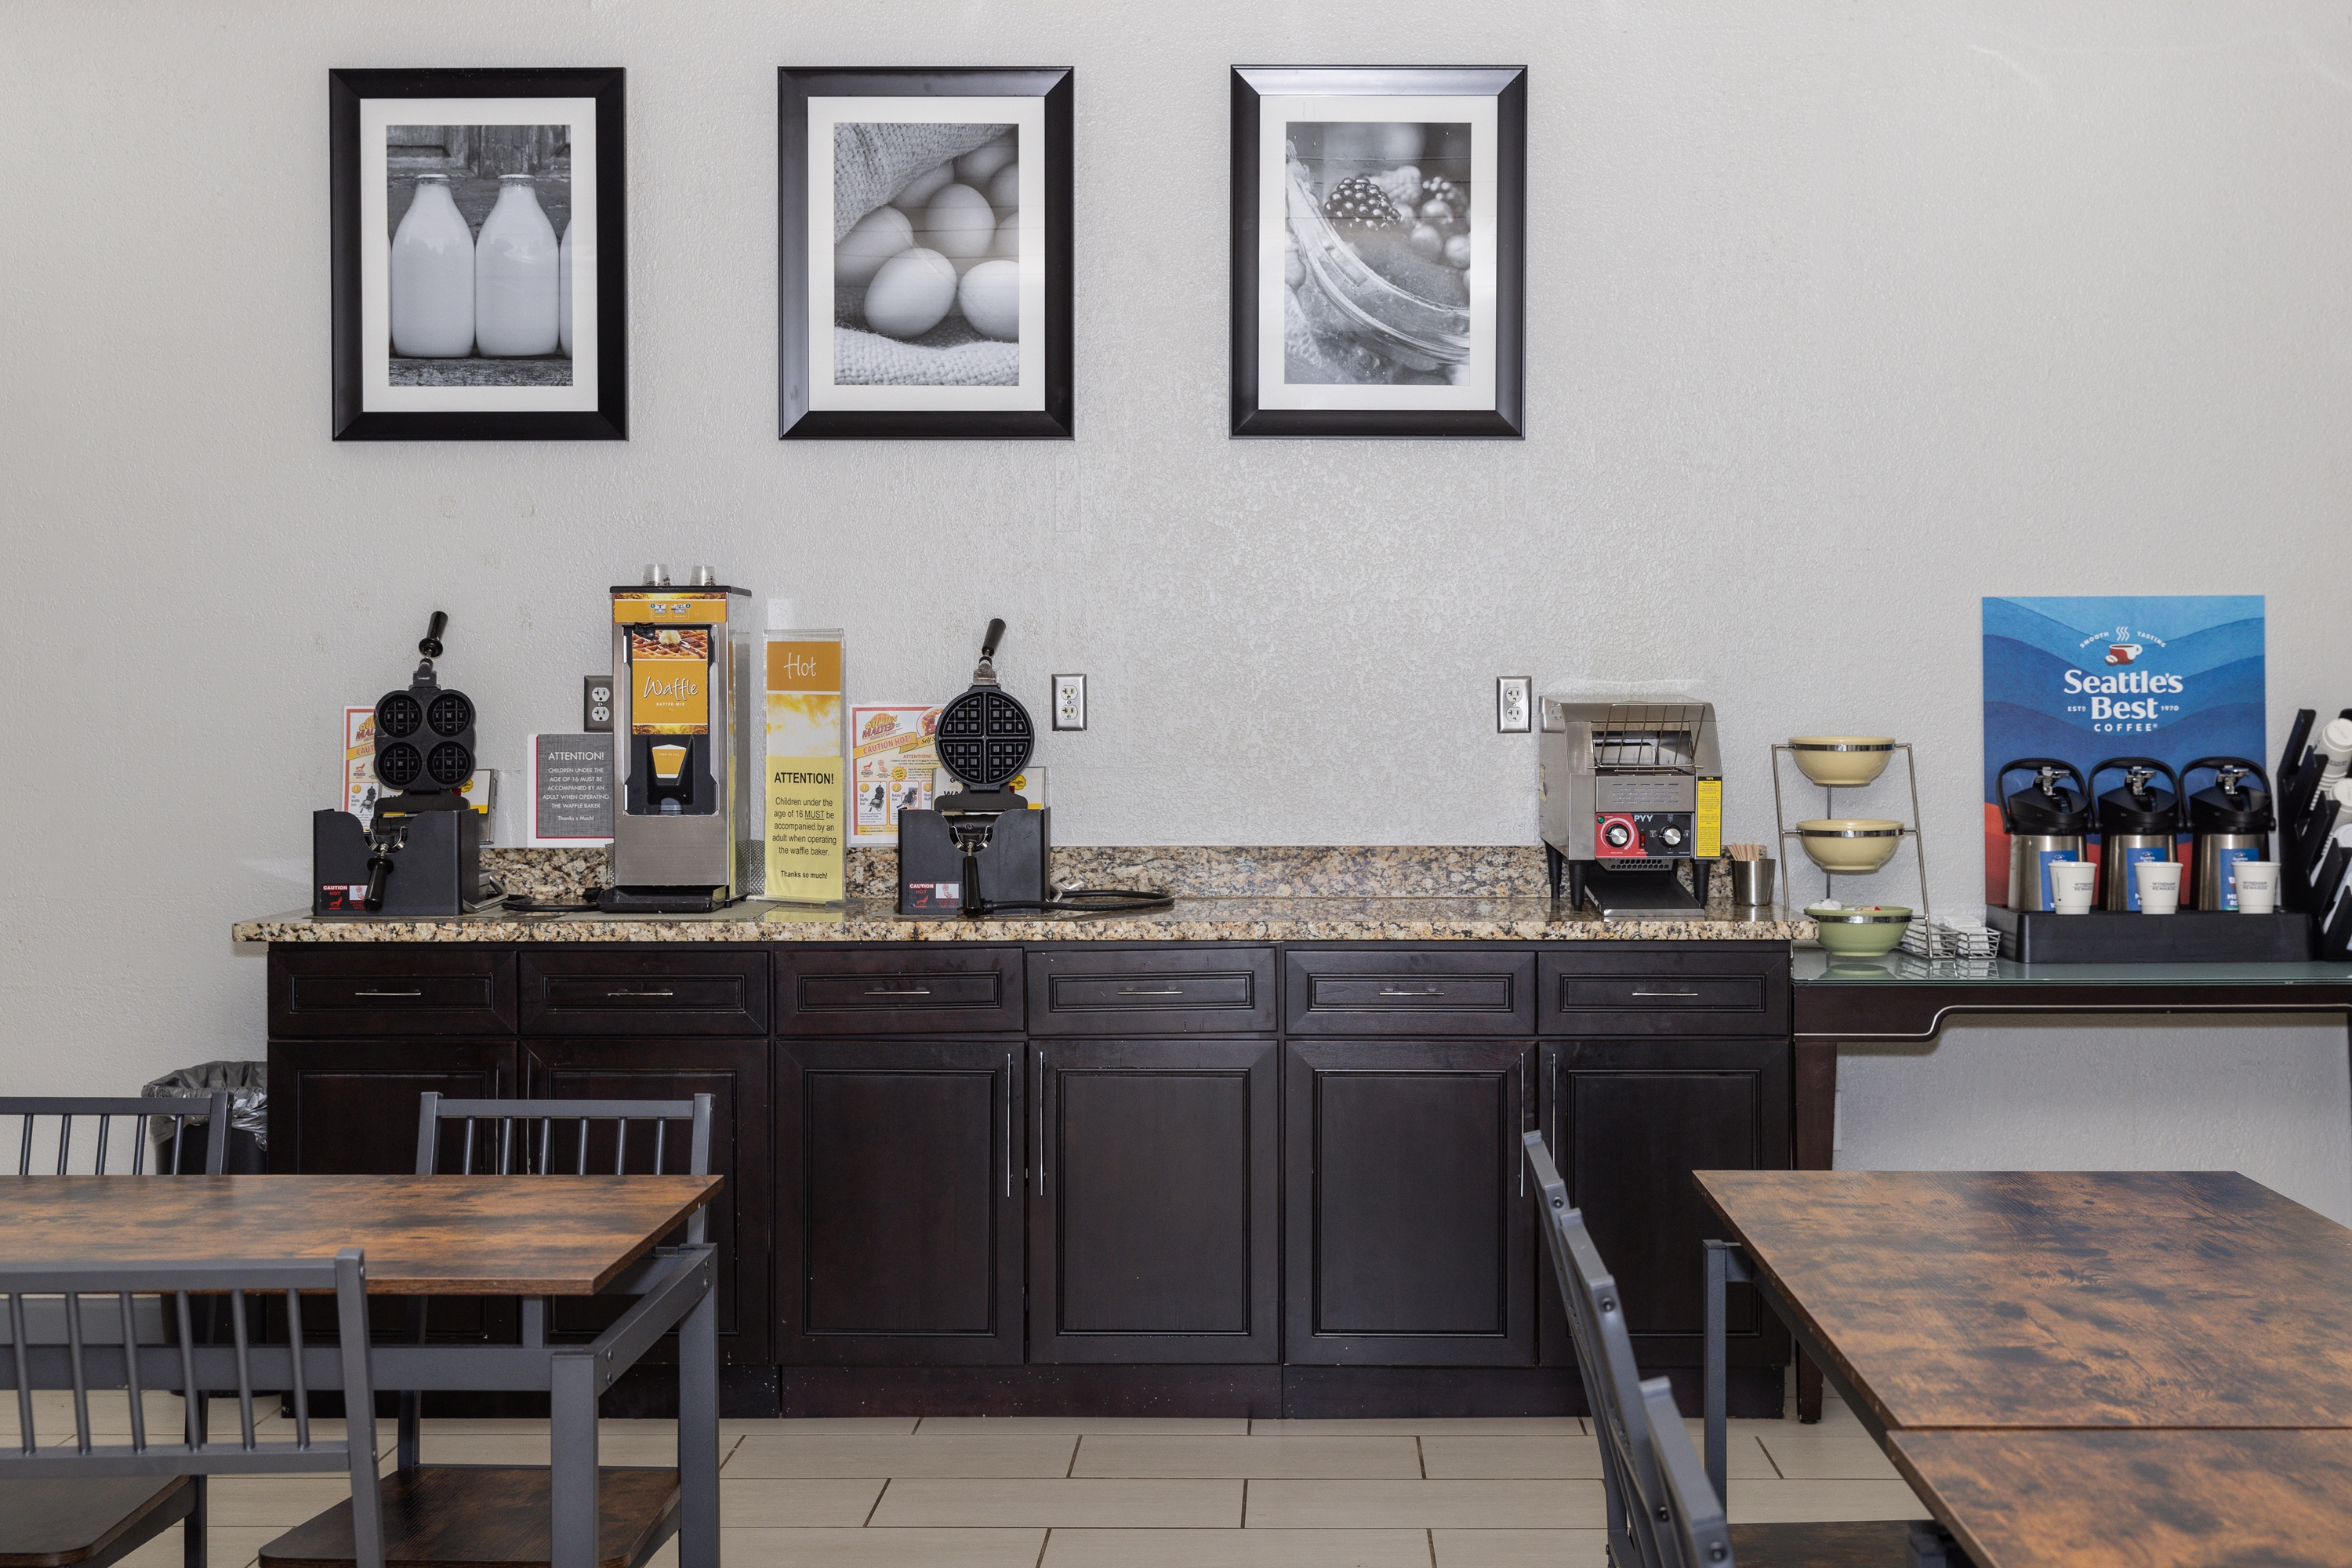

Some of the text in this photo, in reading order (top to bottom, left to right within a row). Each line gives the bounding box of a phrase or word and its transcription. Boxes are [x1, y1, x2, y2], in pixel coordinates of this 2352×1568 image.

[2080, 631, 2109, 648] SMOOTH
[2137, 631, 2167, 648] TASTING
[784, 652, 816, 679] Hot
[644, 677, 699, 701] Waffle
[2063, 670, 2183, 694] Seattle's
[2091, 696, 2158, 719] Best
[865, 715, 898, 729] GOLDEN
[862, 723, 895, 738] MALTED
[357, 746, 374, 755] CAUT
[863, 735, 911, 754] CAUTION HOT!
[548, 752, 604, 760] ATTENTION!
[774, 772, 833, 784] ATTENTION!
[775, 797, 801, 805] Children
[805, 810, 824, 819] MUST
[774, 823, 815, 831] accompanied
[817, 823, 825, 833] by
[808, 836, 836, 845] operating
[790, 847, 809, 855] waffle
[811, 848, 829, 856] baker.
